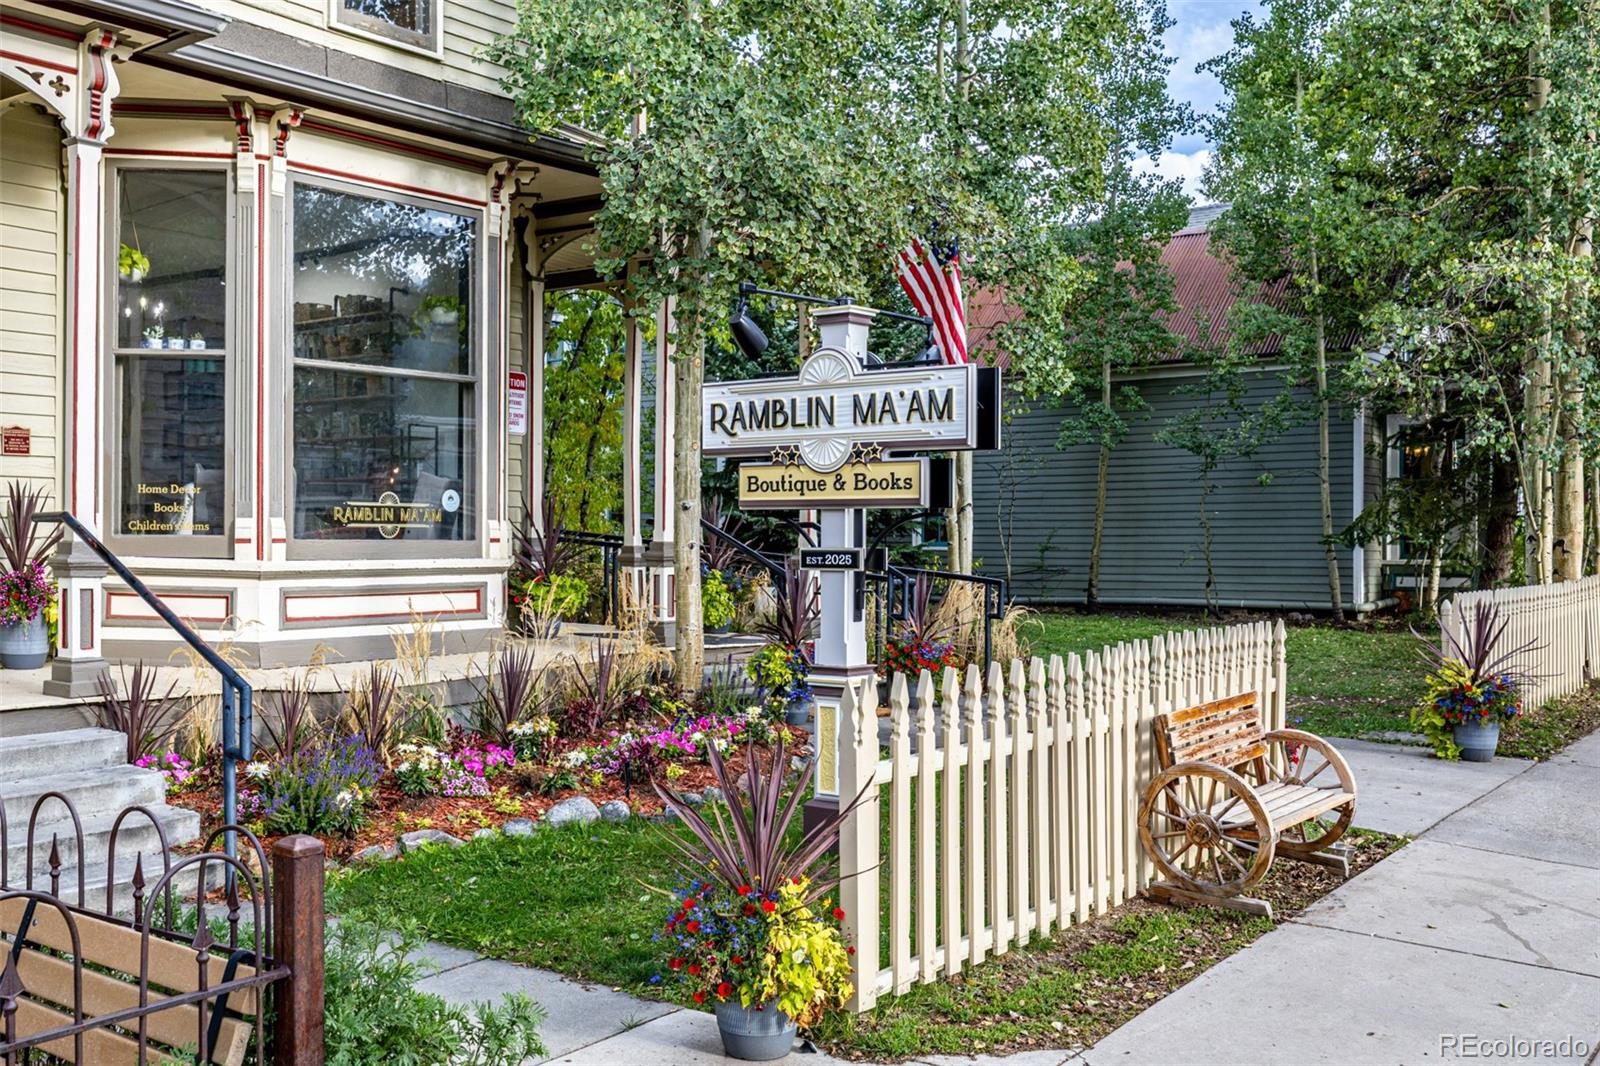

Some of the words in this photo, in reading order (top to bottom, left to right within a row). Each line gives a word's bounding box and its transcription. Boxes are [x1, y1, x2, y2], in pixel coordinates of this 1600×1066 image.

[510, 378, 525, 388] TION
[709, 395, 836, 437] RAMBLIN
[852, 387, 955, 425] MA'AM
[137, 484, 168, 494] Home
[746, 475, 827, 496] Boutique
[833, 473, 848, 490] &
[853, 472, 913, 491] Books
[153, 502, 185, 513] Books
[333, 506, 394, 523] RAMBLIN
[400, 508, 441, 522] MA'AM
